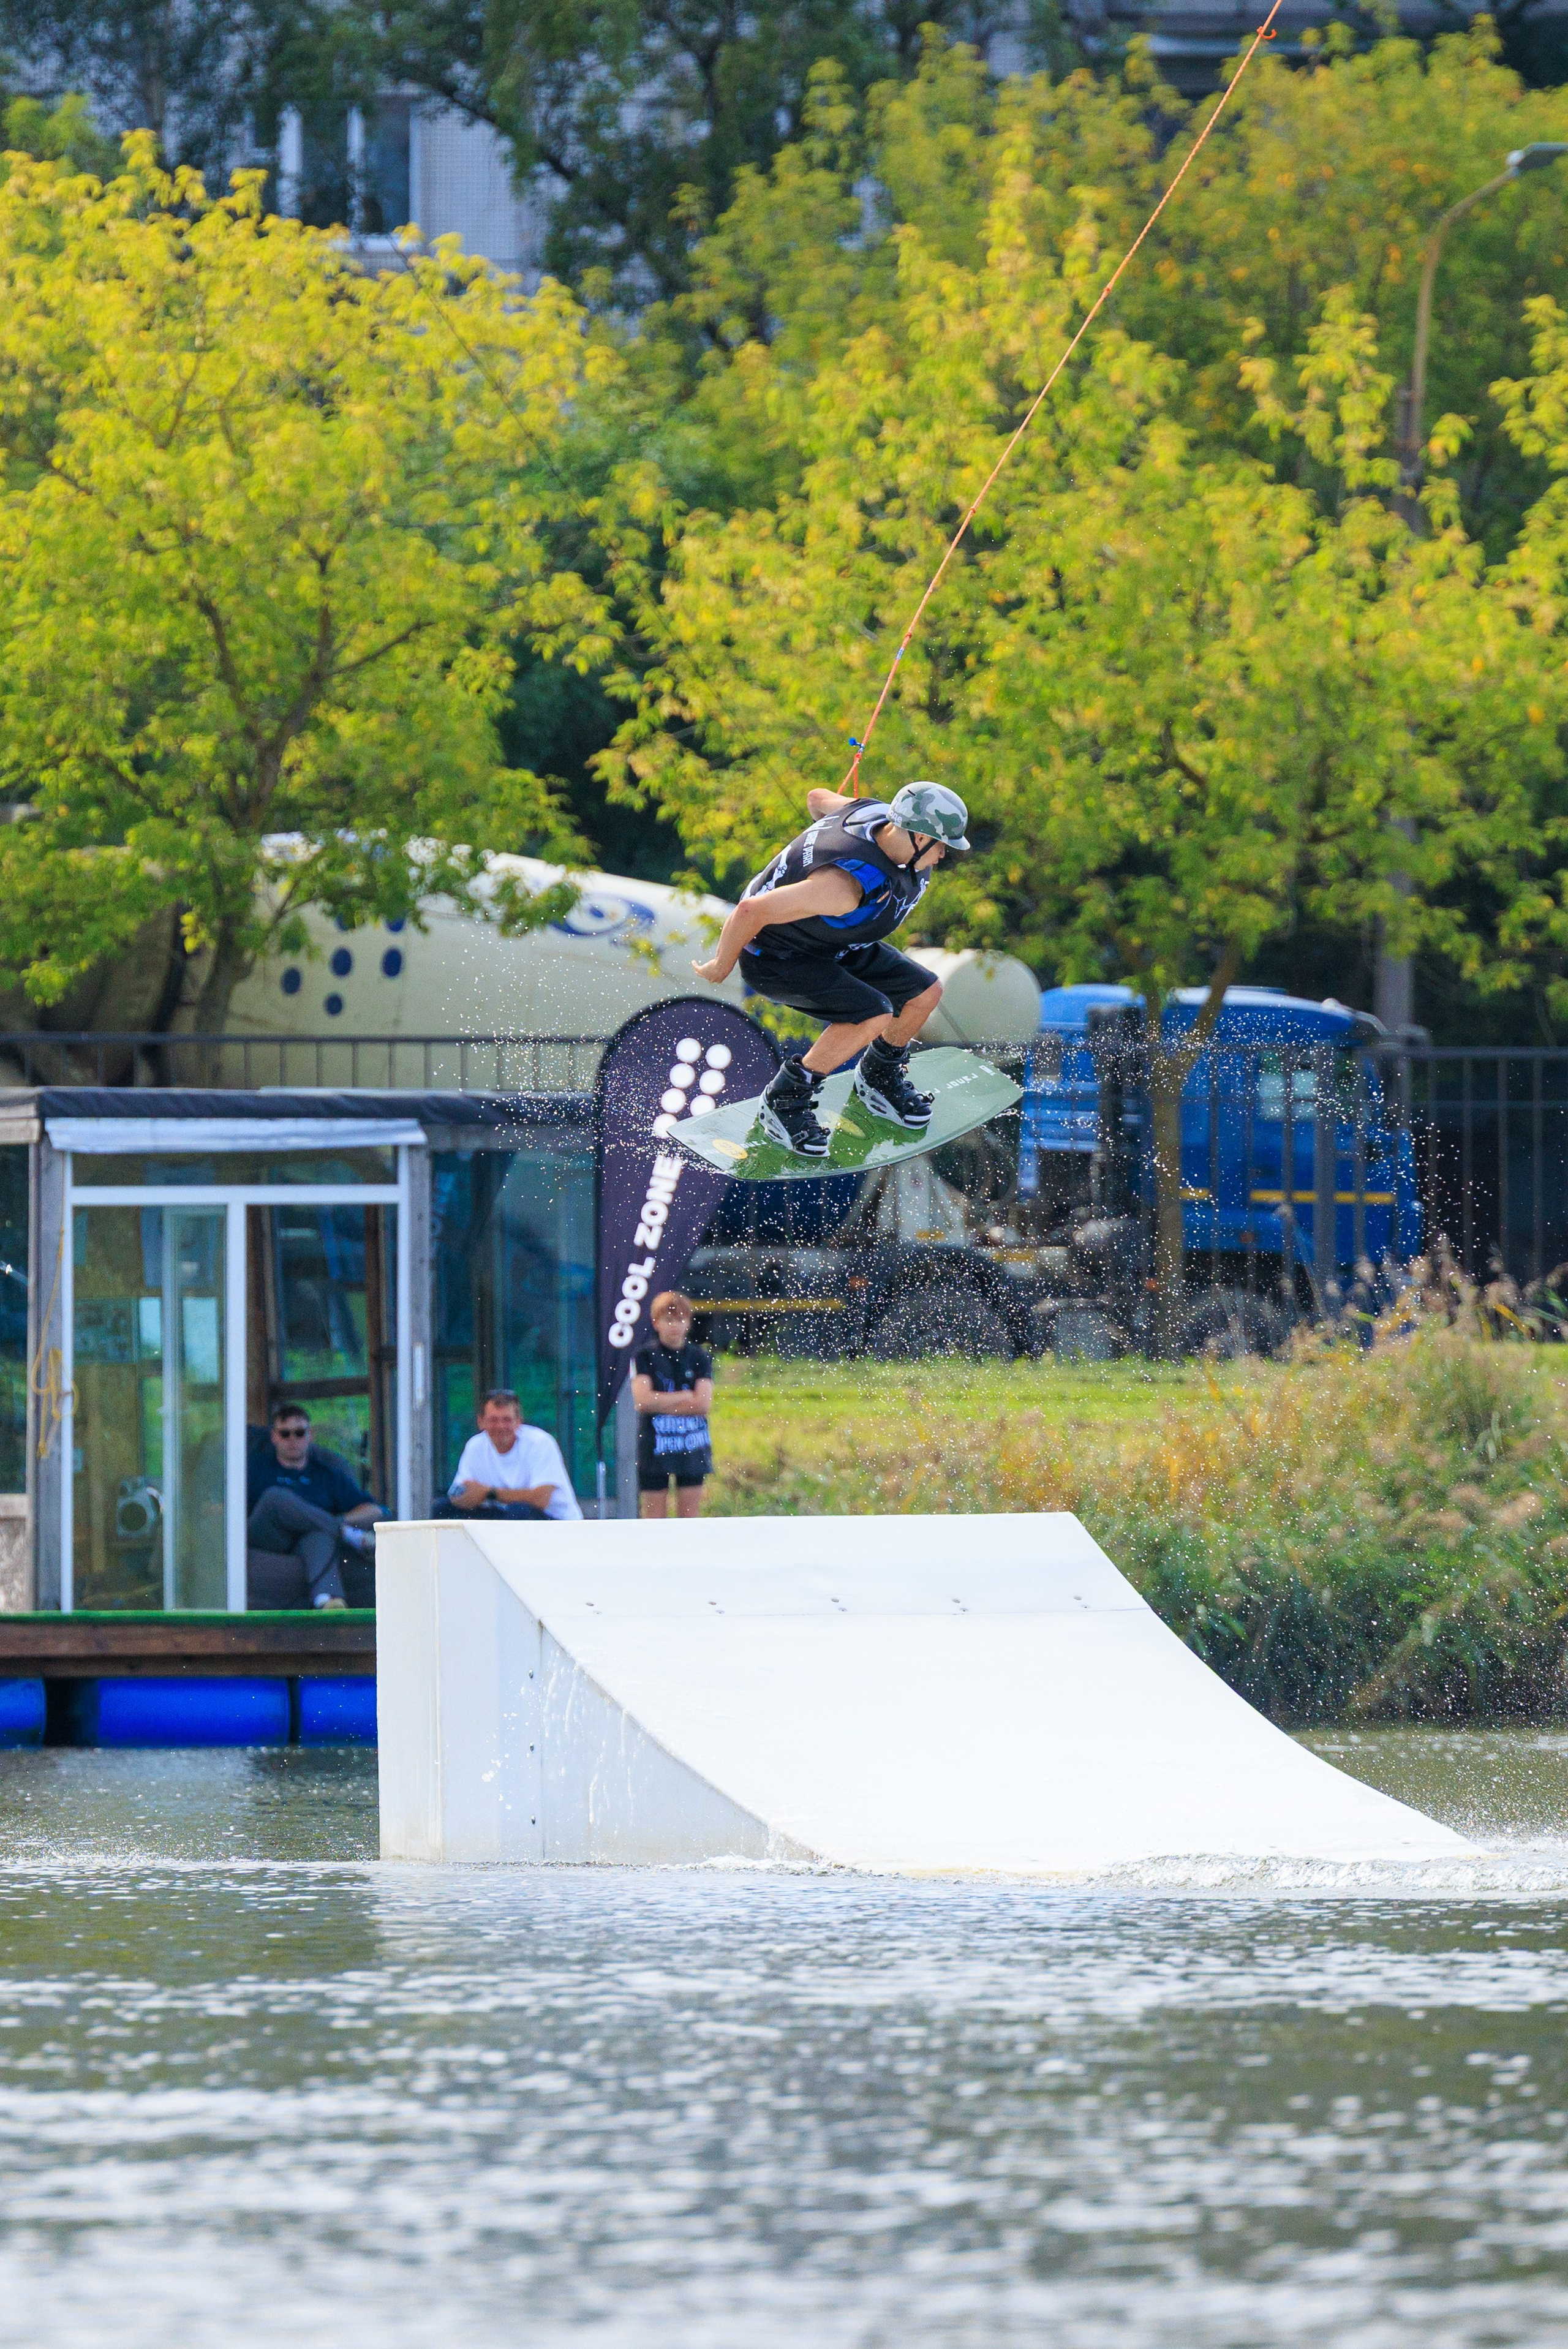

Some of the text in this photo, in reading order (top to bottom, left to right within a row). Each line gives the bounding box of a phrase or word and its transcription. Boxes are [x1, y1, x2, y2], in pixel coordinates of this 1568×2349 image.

[803, 845, 814, 867] PARK
[608, 1155, 682, 1348] COOL ZONE
